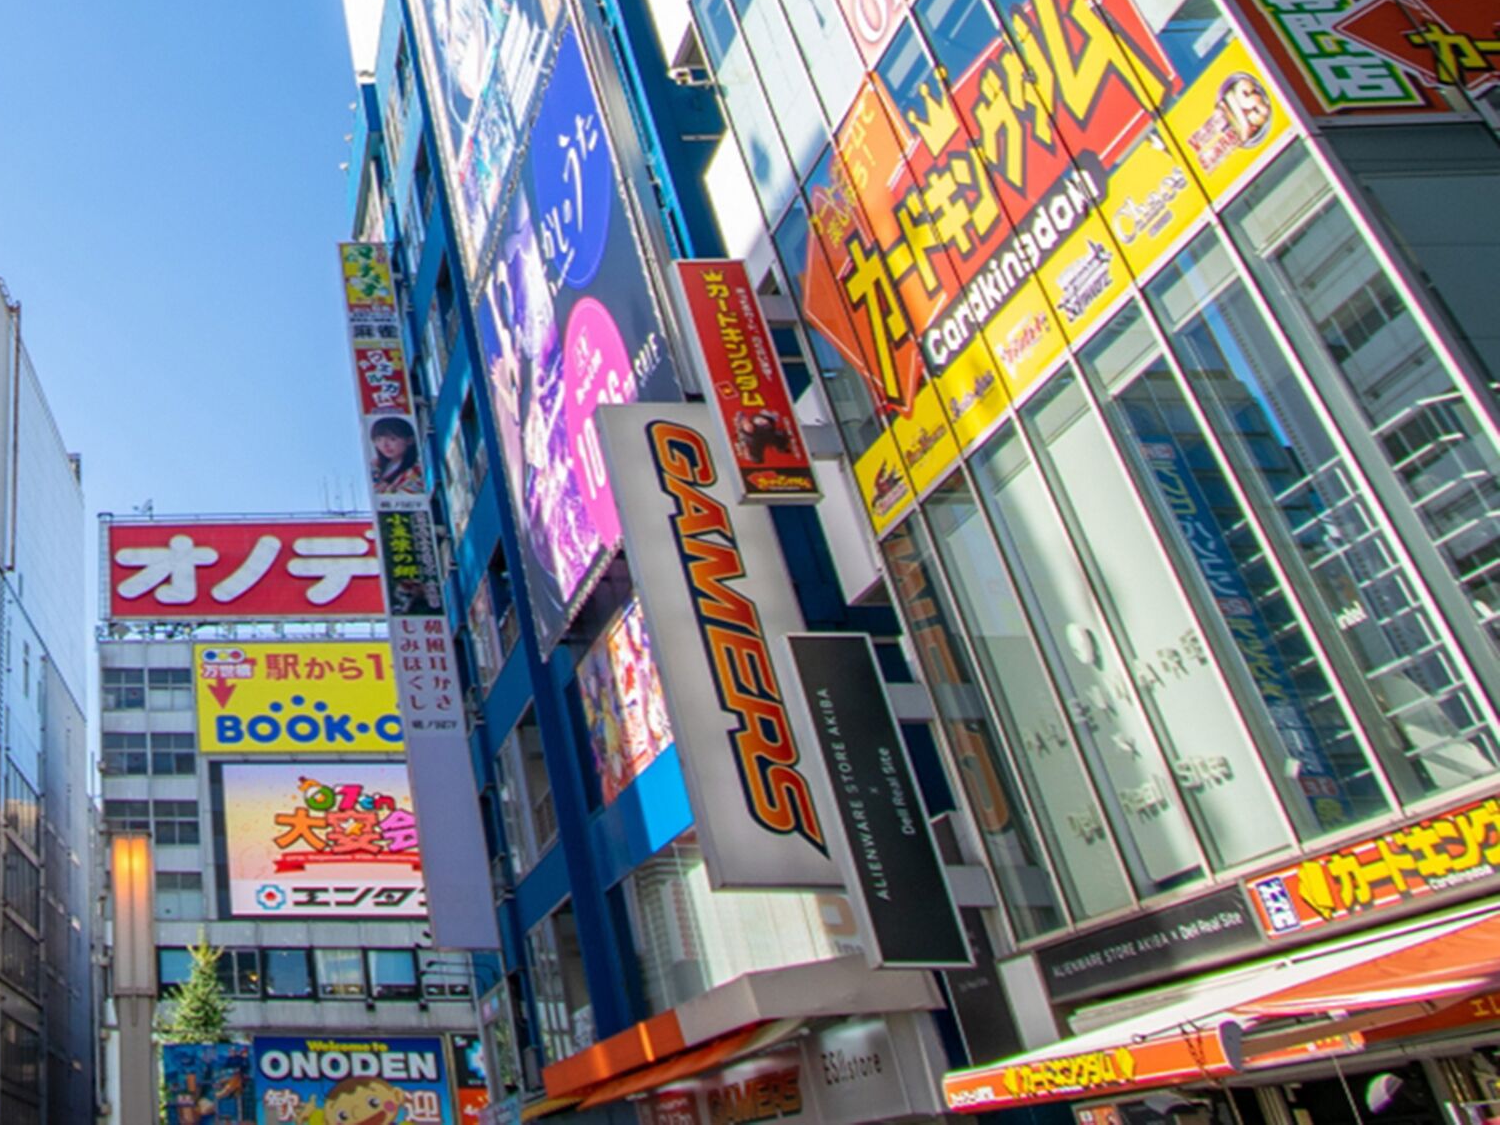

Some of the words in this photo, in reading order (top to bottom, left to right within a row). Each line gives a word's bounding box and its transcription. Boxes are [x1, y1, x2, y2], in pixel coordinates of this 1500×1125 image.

[114, 533, 384, 607] オノデ
[645, 419, 830, 861] GAMERS
[819, 686, 851, 735] AKIBA
[836, 736, 862, 795] STORE
[875, 746, 901, 777] Site
[897, 811, 917, 836] Dell
[850, 799, 892, 902] ALIENWARE
[259, 1051, 438, 1080] ONODEN
[305, 1040, 368, 1052] Welcome
[372, 1040, 389, 1053] to
[403, 1090, 443, 1124] 迎
